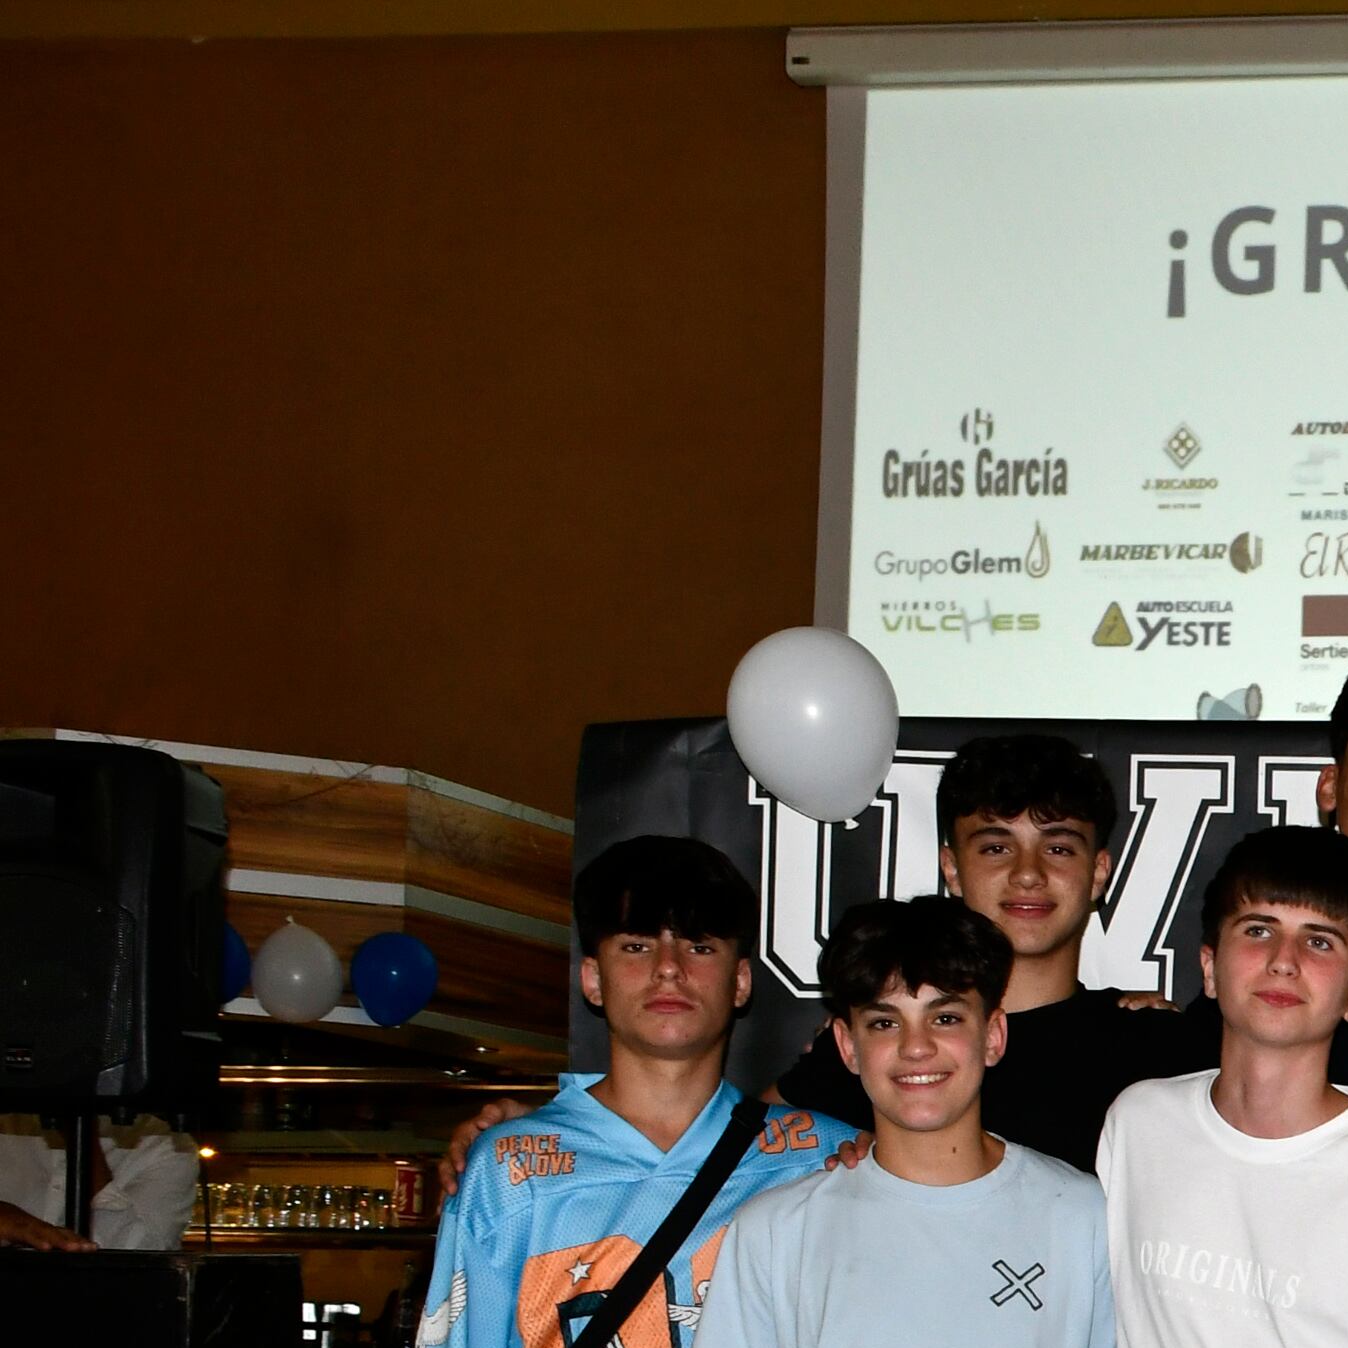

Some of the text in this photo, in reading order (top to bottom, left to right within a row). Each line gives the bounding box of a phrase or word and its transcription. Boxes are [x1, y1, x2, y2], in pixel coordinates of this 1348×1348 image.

[883, 446, 1068, 498] Grúas García
[1080, 543, 1228, 561] MARBEVICAR
[881, 597, 1041, 644] VILCHES
[1136, 601, 1234, 613] AUTOESCUELA
[1135, 617, 1232, 651] YESTE
[495, 1134, 561, 1164] PEACE
